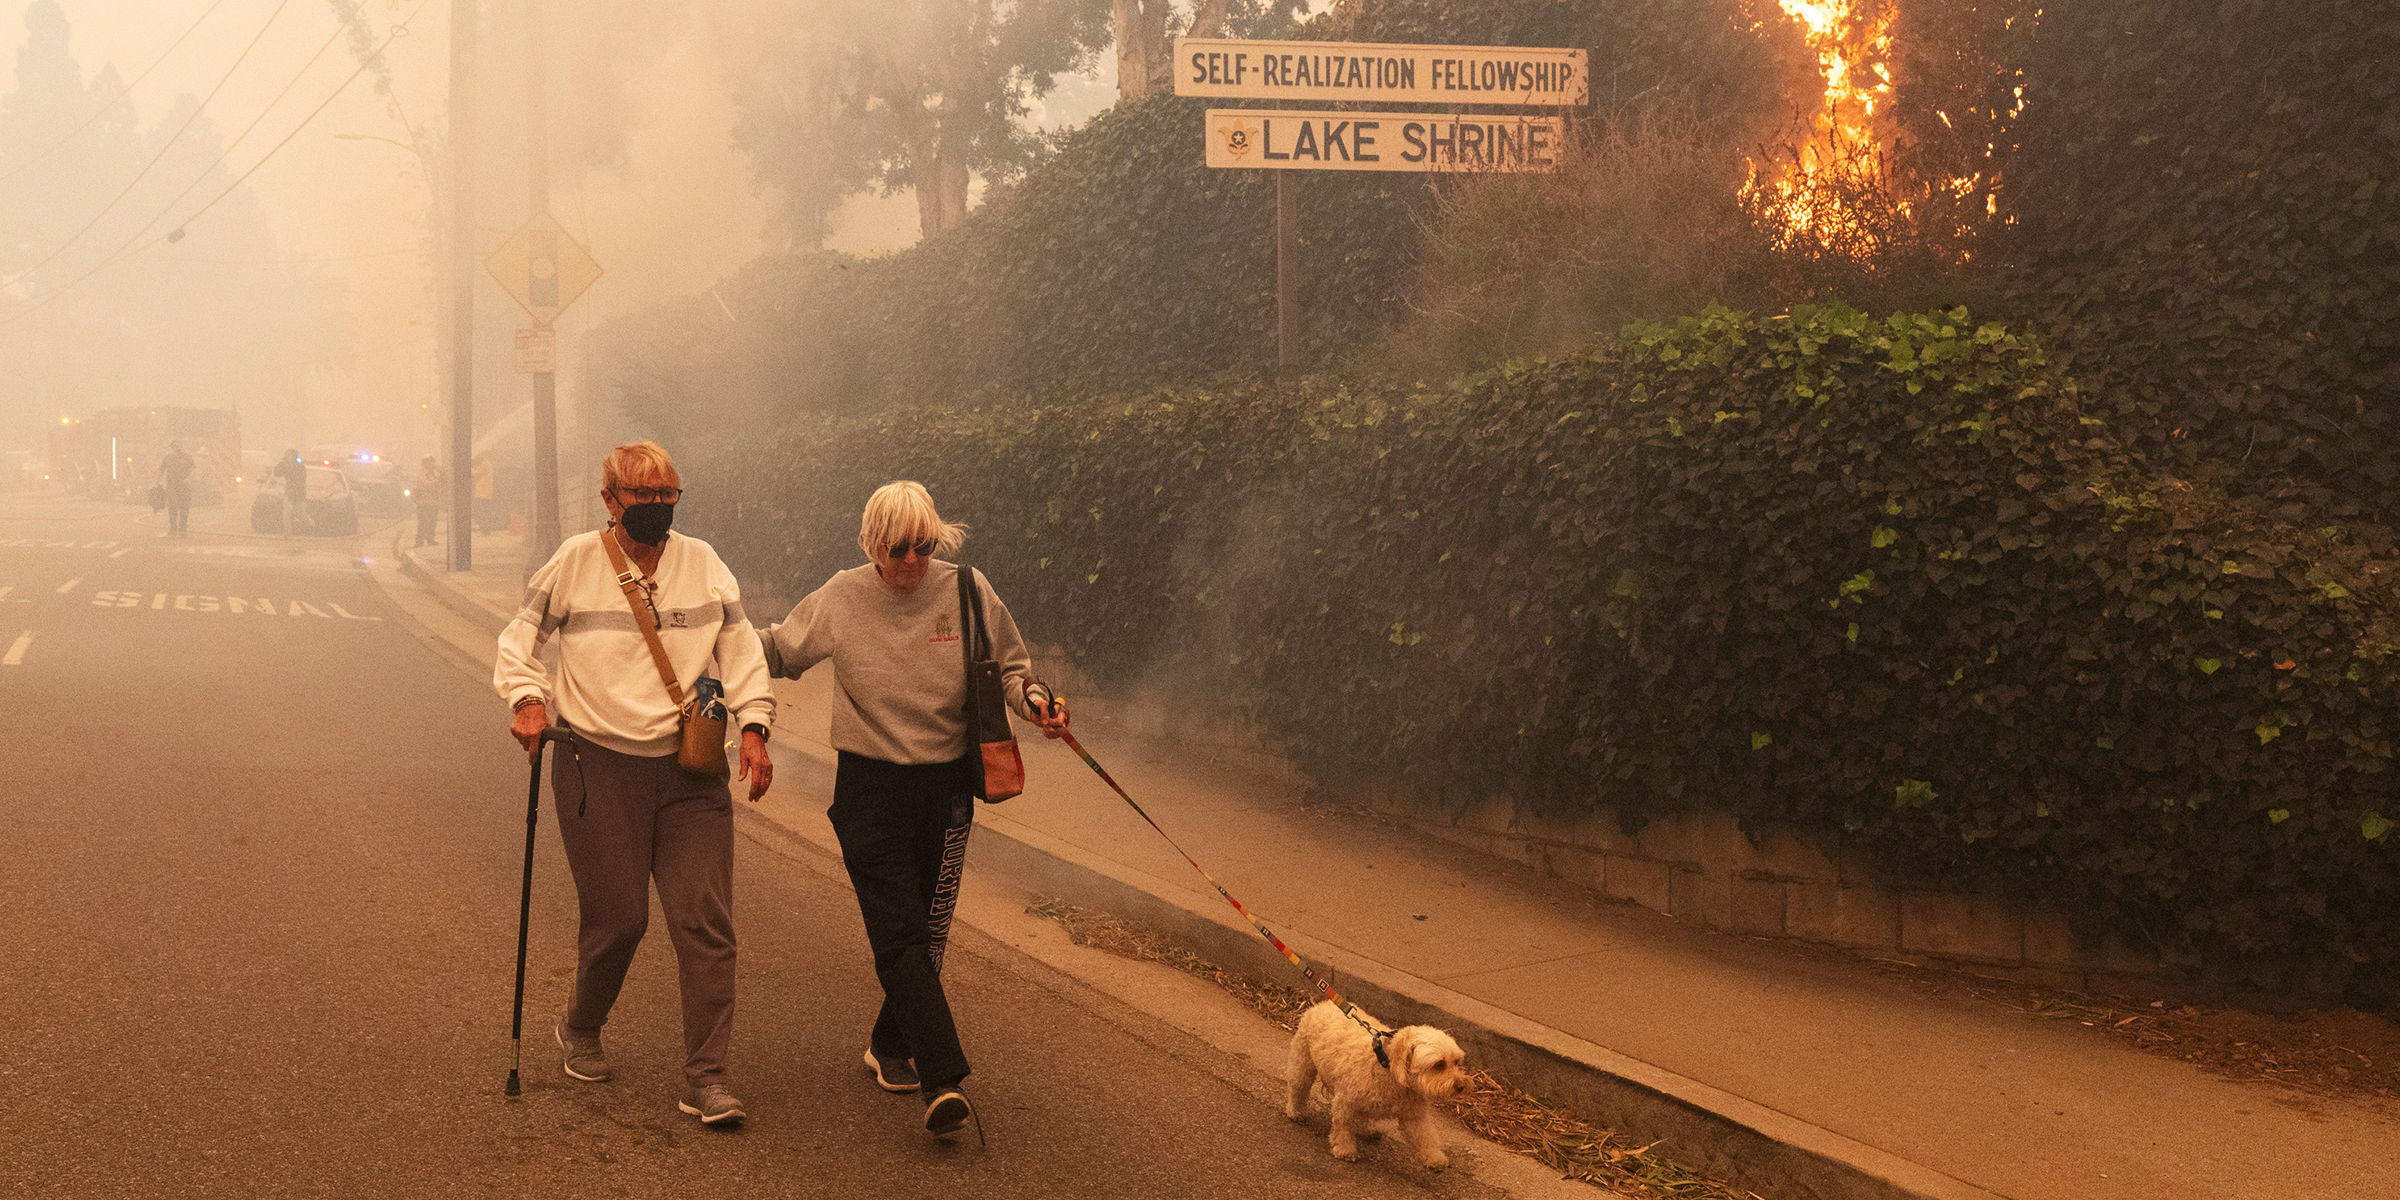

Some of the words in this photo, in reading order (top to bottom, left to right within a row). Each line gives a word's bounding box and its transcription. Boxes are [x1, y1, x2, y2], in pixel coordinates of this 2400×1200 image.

[1191, 52, 1415, 90] SELF-REALIZATION
[1432, 58, 1573, 93] FELLOWSHIP
[1263, 119, 1380, 162] LAKE
[1401, 121, 1553, 165] SHRINE
[92, 591, 382, 620] SIGNAL
